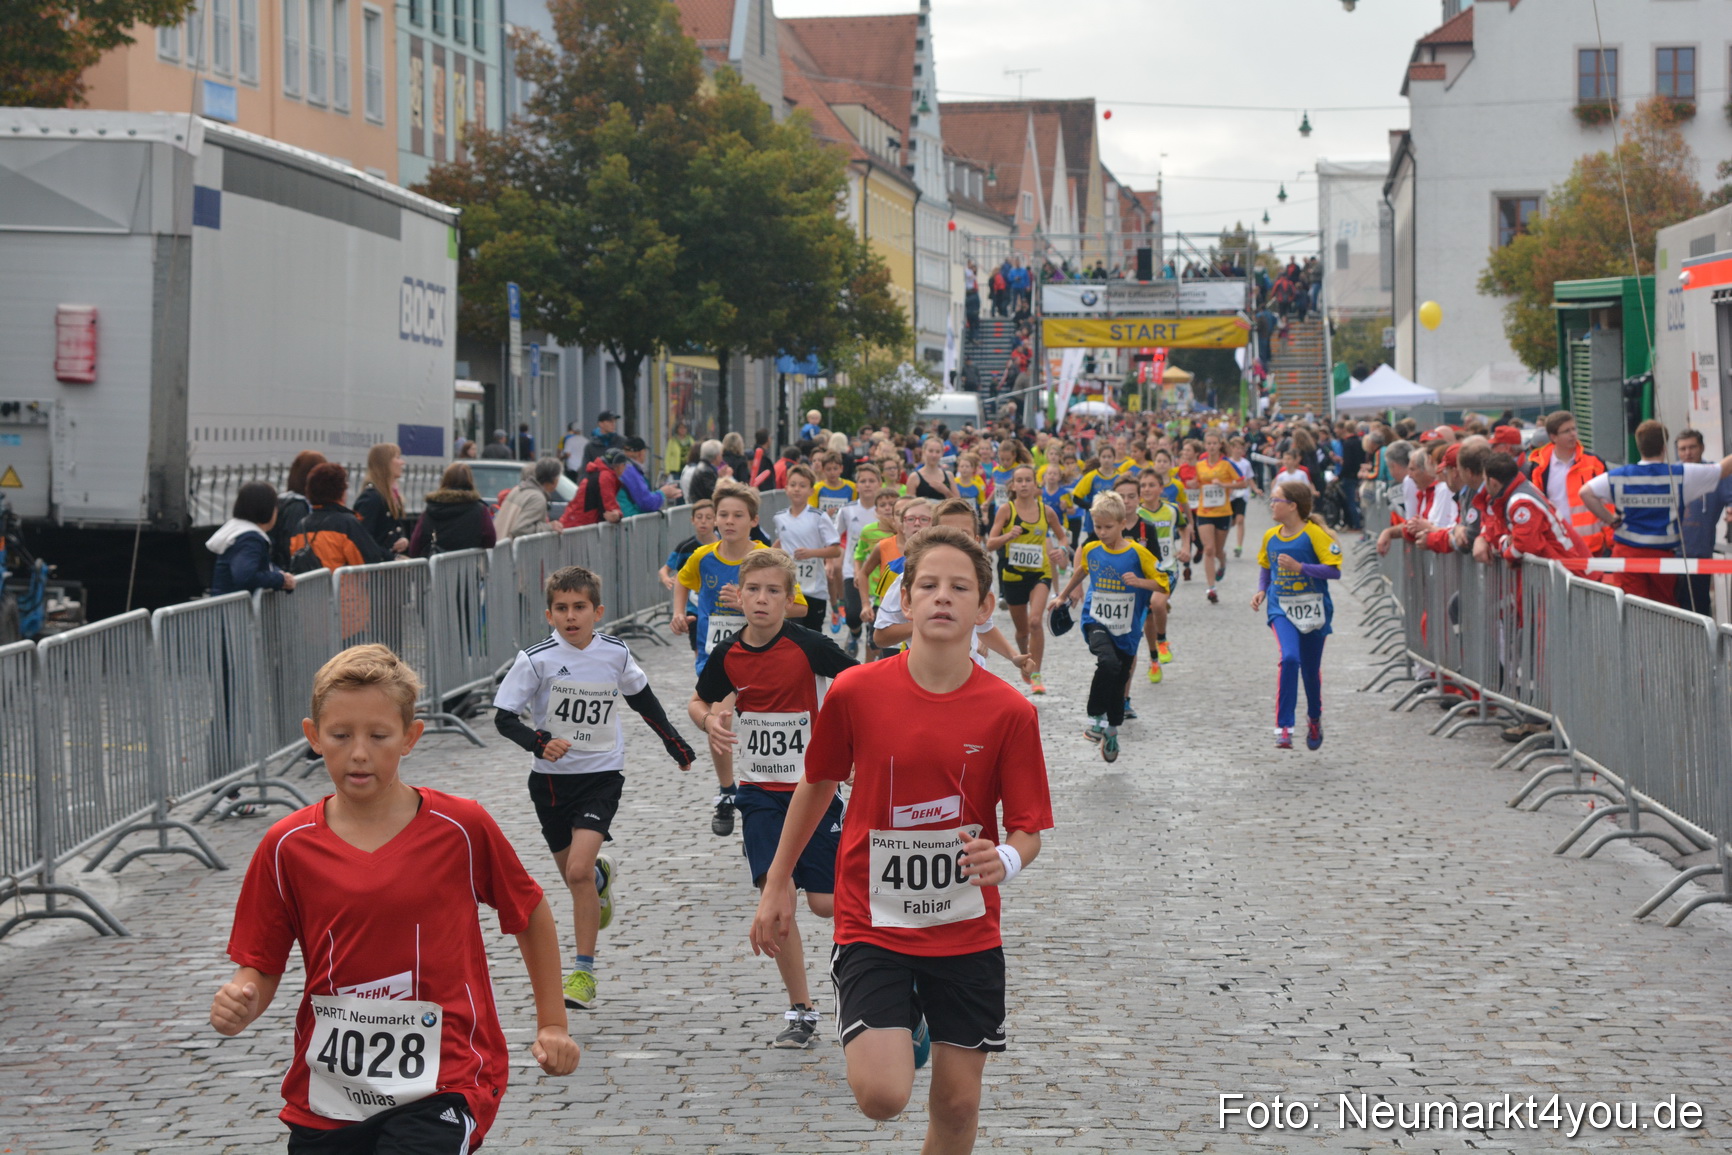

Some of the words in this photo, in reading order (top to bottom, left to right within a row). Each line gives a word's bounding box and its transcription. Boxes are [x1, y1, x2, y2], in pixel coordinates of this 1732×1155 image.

[400, 276, 446, 346] BOCK
[1110, 323, 1180, 341] START
[1620, 496, 1674, 505] SEG-LEITER
[1012, 551, 1040, 565] 4002
[798, 564, 813, 578] 12
[1095, 603, 1129, 619] 4041
[1286, 603, 1321, 620] 4024
[712, 629, 733, 644] 40
[551, 685, 577, 695] PARTL
[579, 689, 611, 697] Neumarkt
[554, 698, 614, 725] 4037
[740, 718, 761, 726] PARTL
[761, 719, 796, 727] Neumarkt
[573, 730, 591, 742] Jan
[747, 729, 804, 756] 4034
[750, 762, 796, 773] Jonathan
[911, 806, 943, 820] DEHN
[872, 838, 910, 850] PARTL
[913, 836, 964, 849] Neumark
[903, 899, 951, 914] Fabian
[315, 1005, 347, 1021] PARTL
[349, 1010, 416, 1026] Neumarkt
[316, 1027, 425, 1079] 4028
[343, 1085, 396, 1106] Tobias
